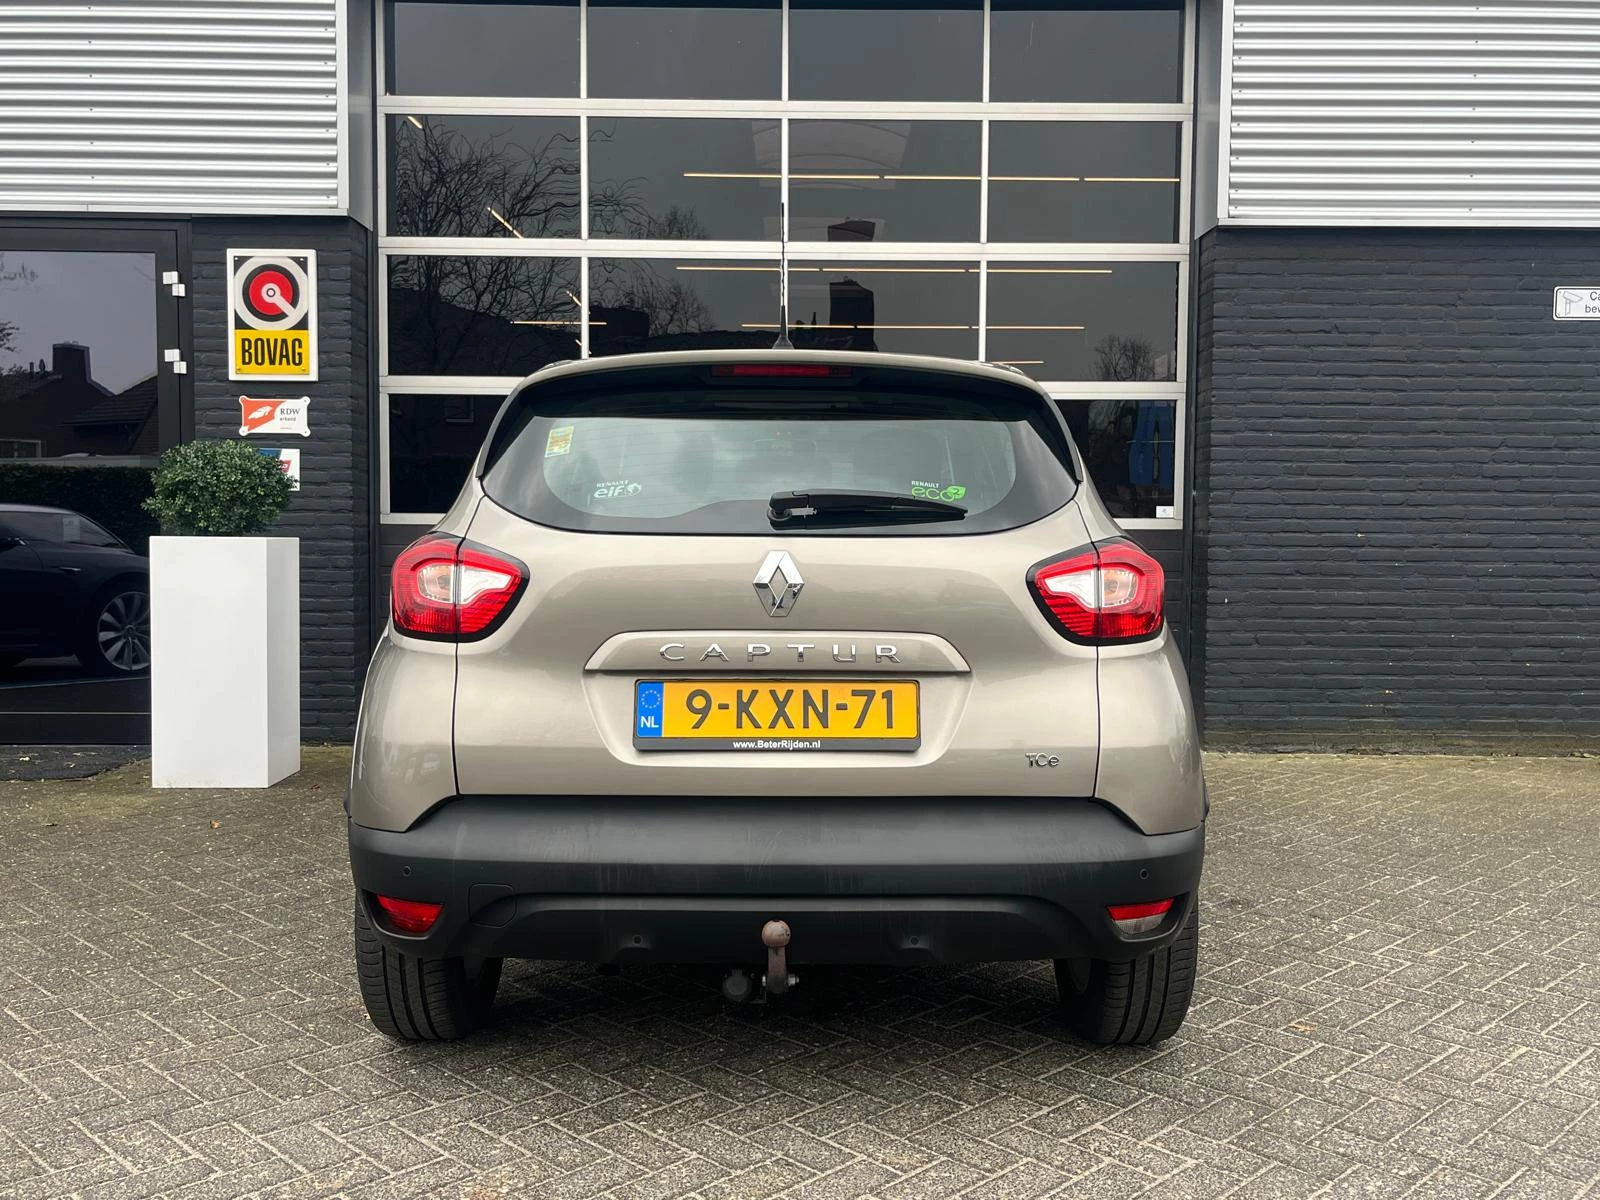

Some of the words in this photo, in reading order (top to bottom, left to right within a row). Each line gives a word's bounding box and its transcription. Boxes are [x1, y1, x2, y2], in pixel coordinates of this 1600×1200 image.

[241, 337, 303, 366] BOVAG
[911, 480, 939, 488] RENAULT
[594, 486, 625, 498] elf
[659, 643, 901, 663] CAPTUR
[685, 689, 894, 730] 9-KXN-71
[640, 716, 660, 728] NL
[732, 740, 821, 751] www.BeterRijden.nl
[1025, 752, 1060, 768] TCe
